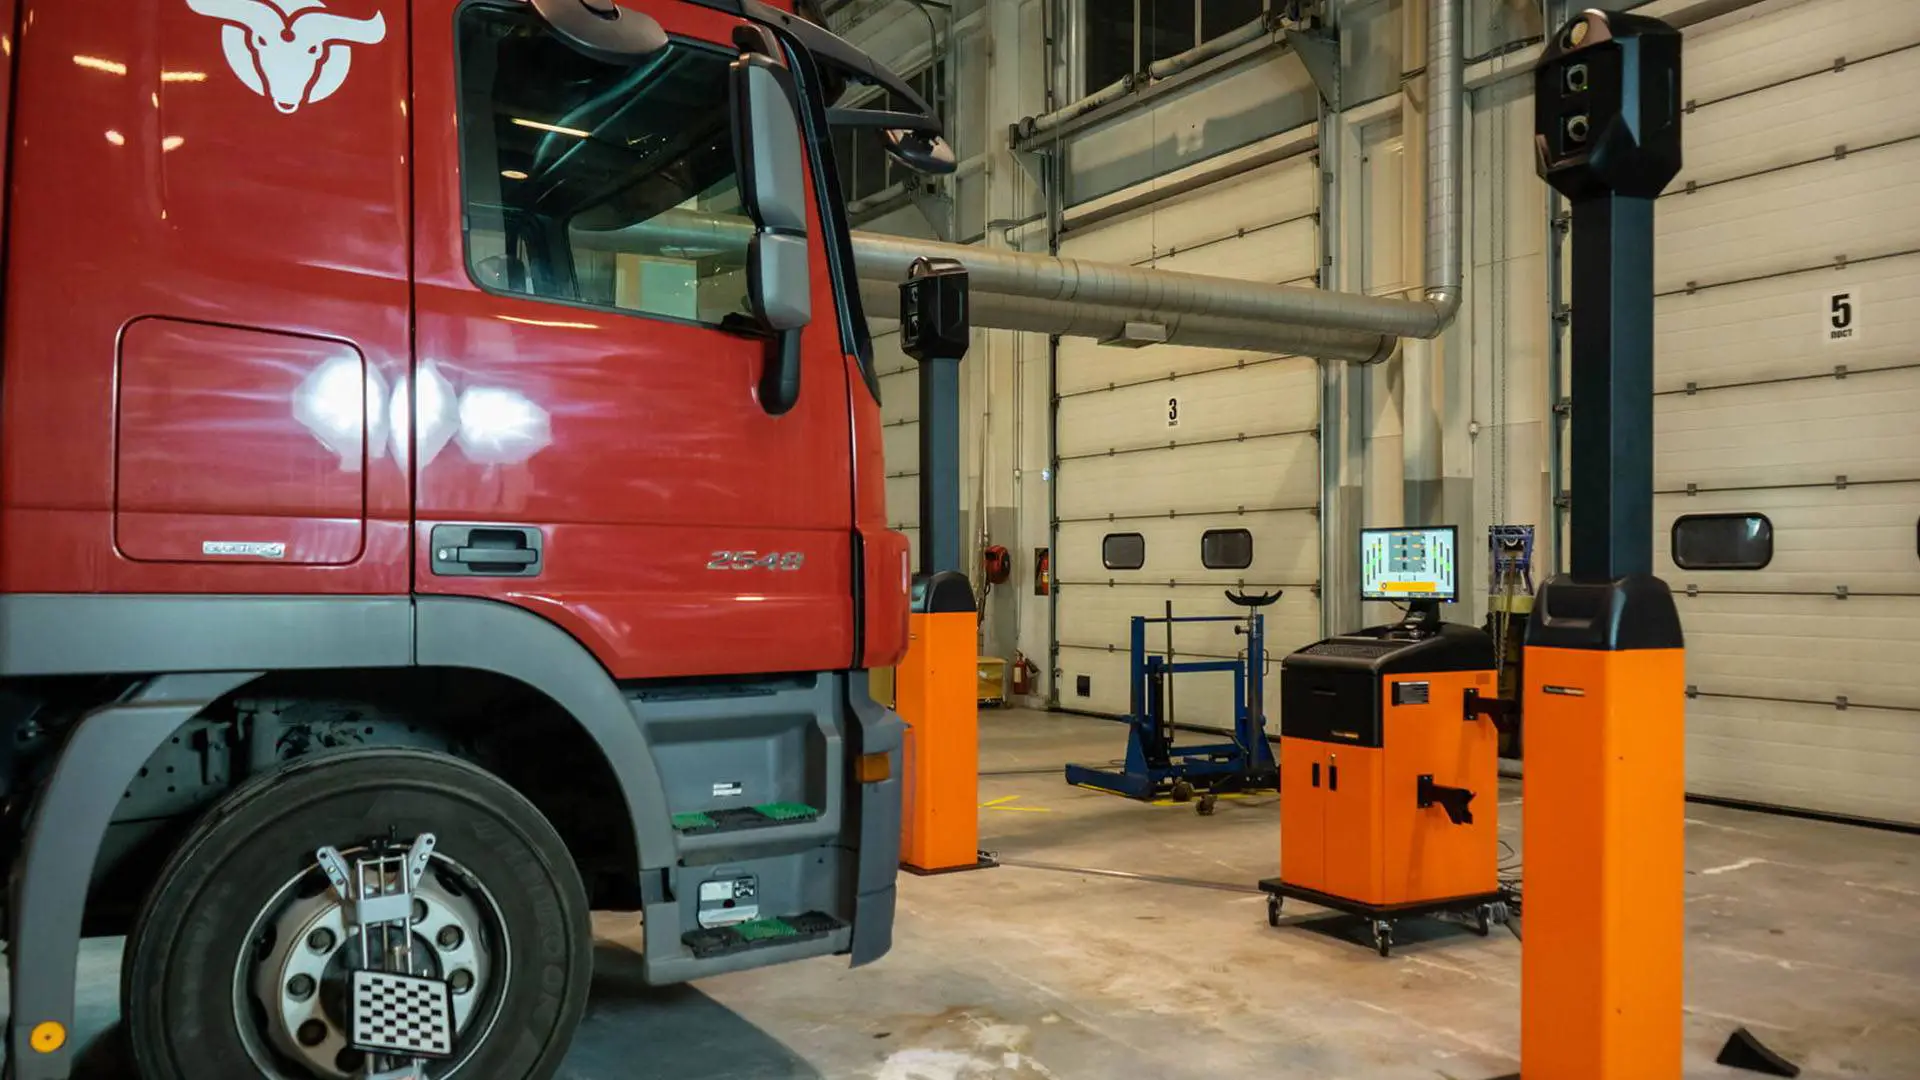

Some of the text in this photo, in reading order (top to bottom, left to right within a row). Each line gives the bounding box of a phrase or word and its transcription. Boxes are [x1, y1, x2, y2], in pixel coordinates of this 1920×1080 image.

[1831, 293, 1851, 328] 5
[1169, 398, 1177, 420] 3
[706, 550, 804, 570] 2548
